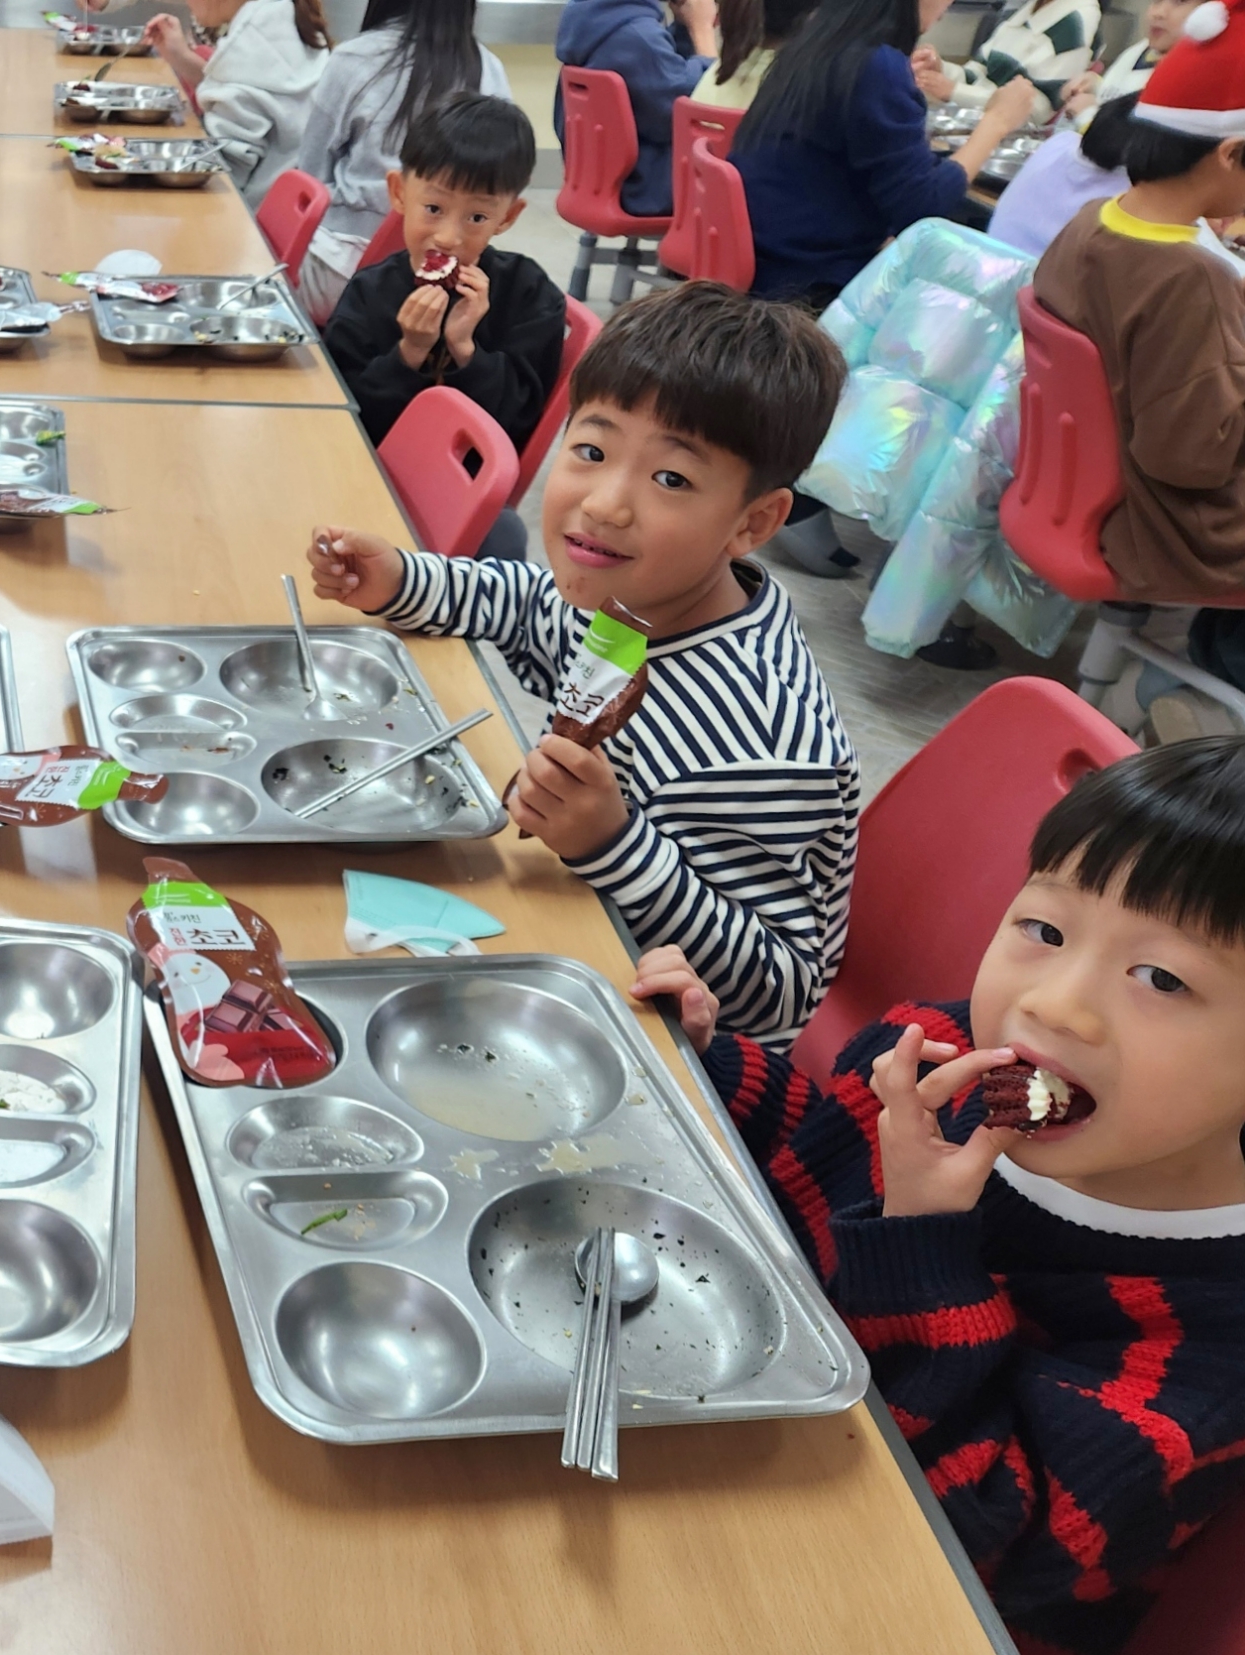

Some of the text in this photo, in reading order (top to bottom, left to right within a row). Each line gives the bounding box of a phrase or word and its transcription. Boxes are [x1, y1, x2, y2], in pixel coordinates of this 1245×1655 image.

[560, 682, 604, 717] 초코
[25, 775, 62, 798] 초코
[186, 928, 246, 946] 초코
